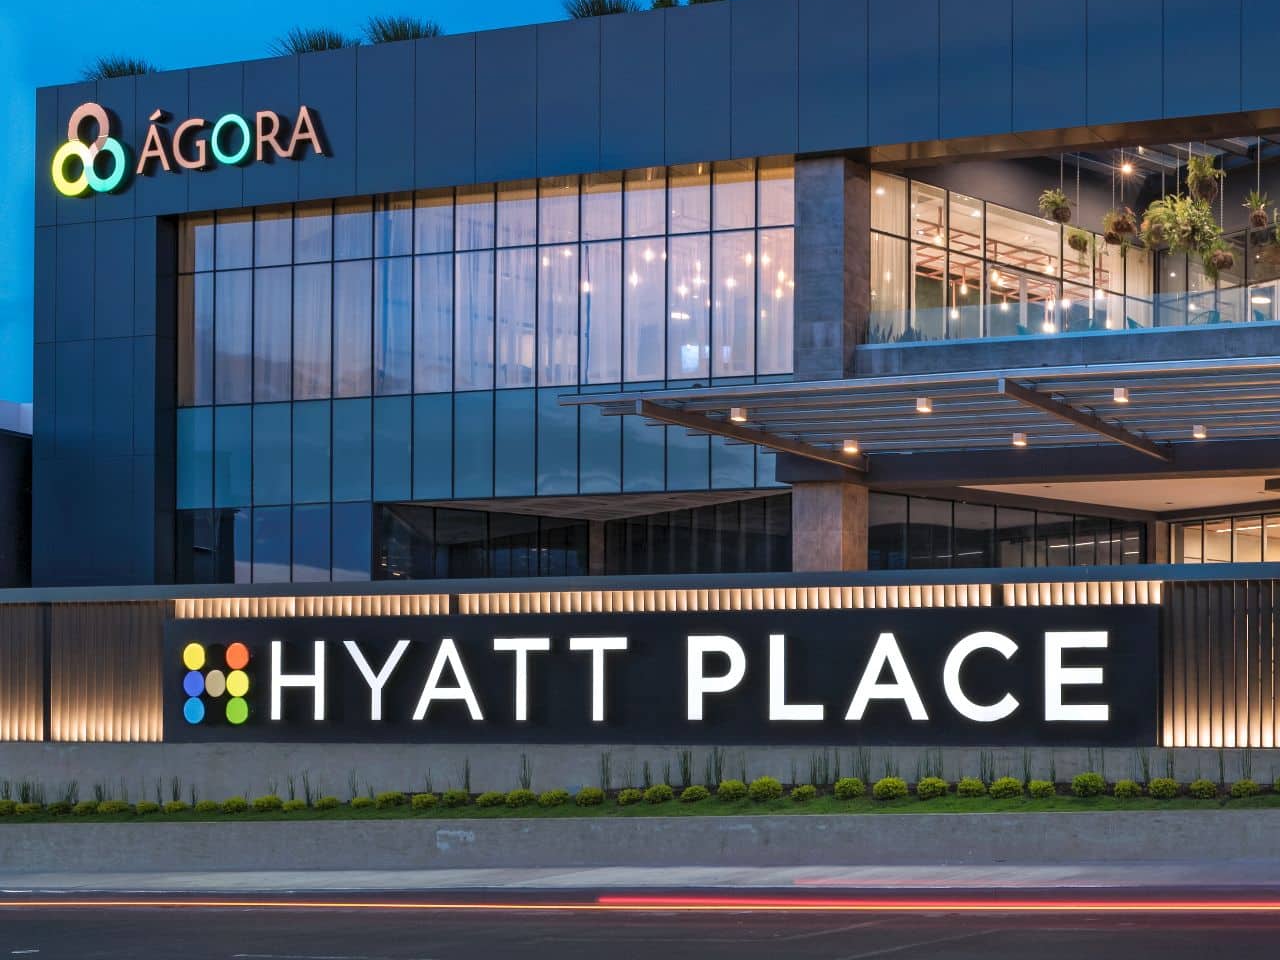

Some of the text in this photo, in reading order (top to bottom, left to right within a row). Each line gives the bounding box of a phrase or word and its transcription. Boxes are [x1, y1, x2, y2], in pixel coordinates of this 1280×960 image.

[136, 105, 324, 176] ÁGORA
[270, 630, 1110, 723] HYATT PLACE
